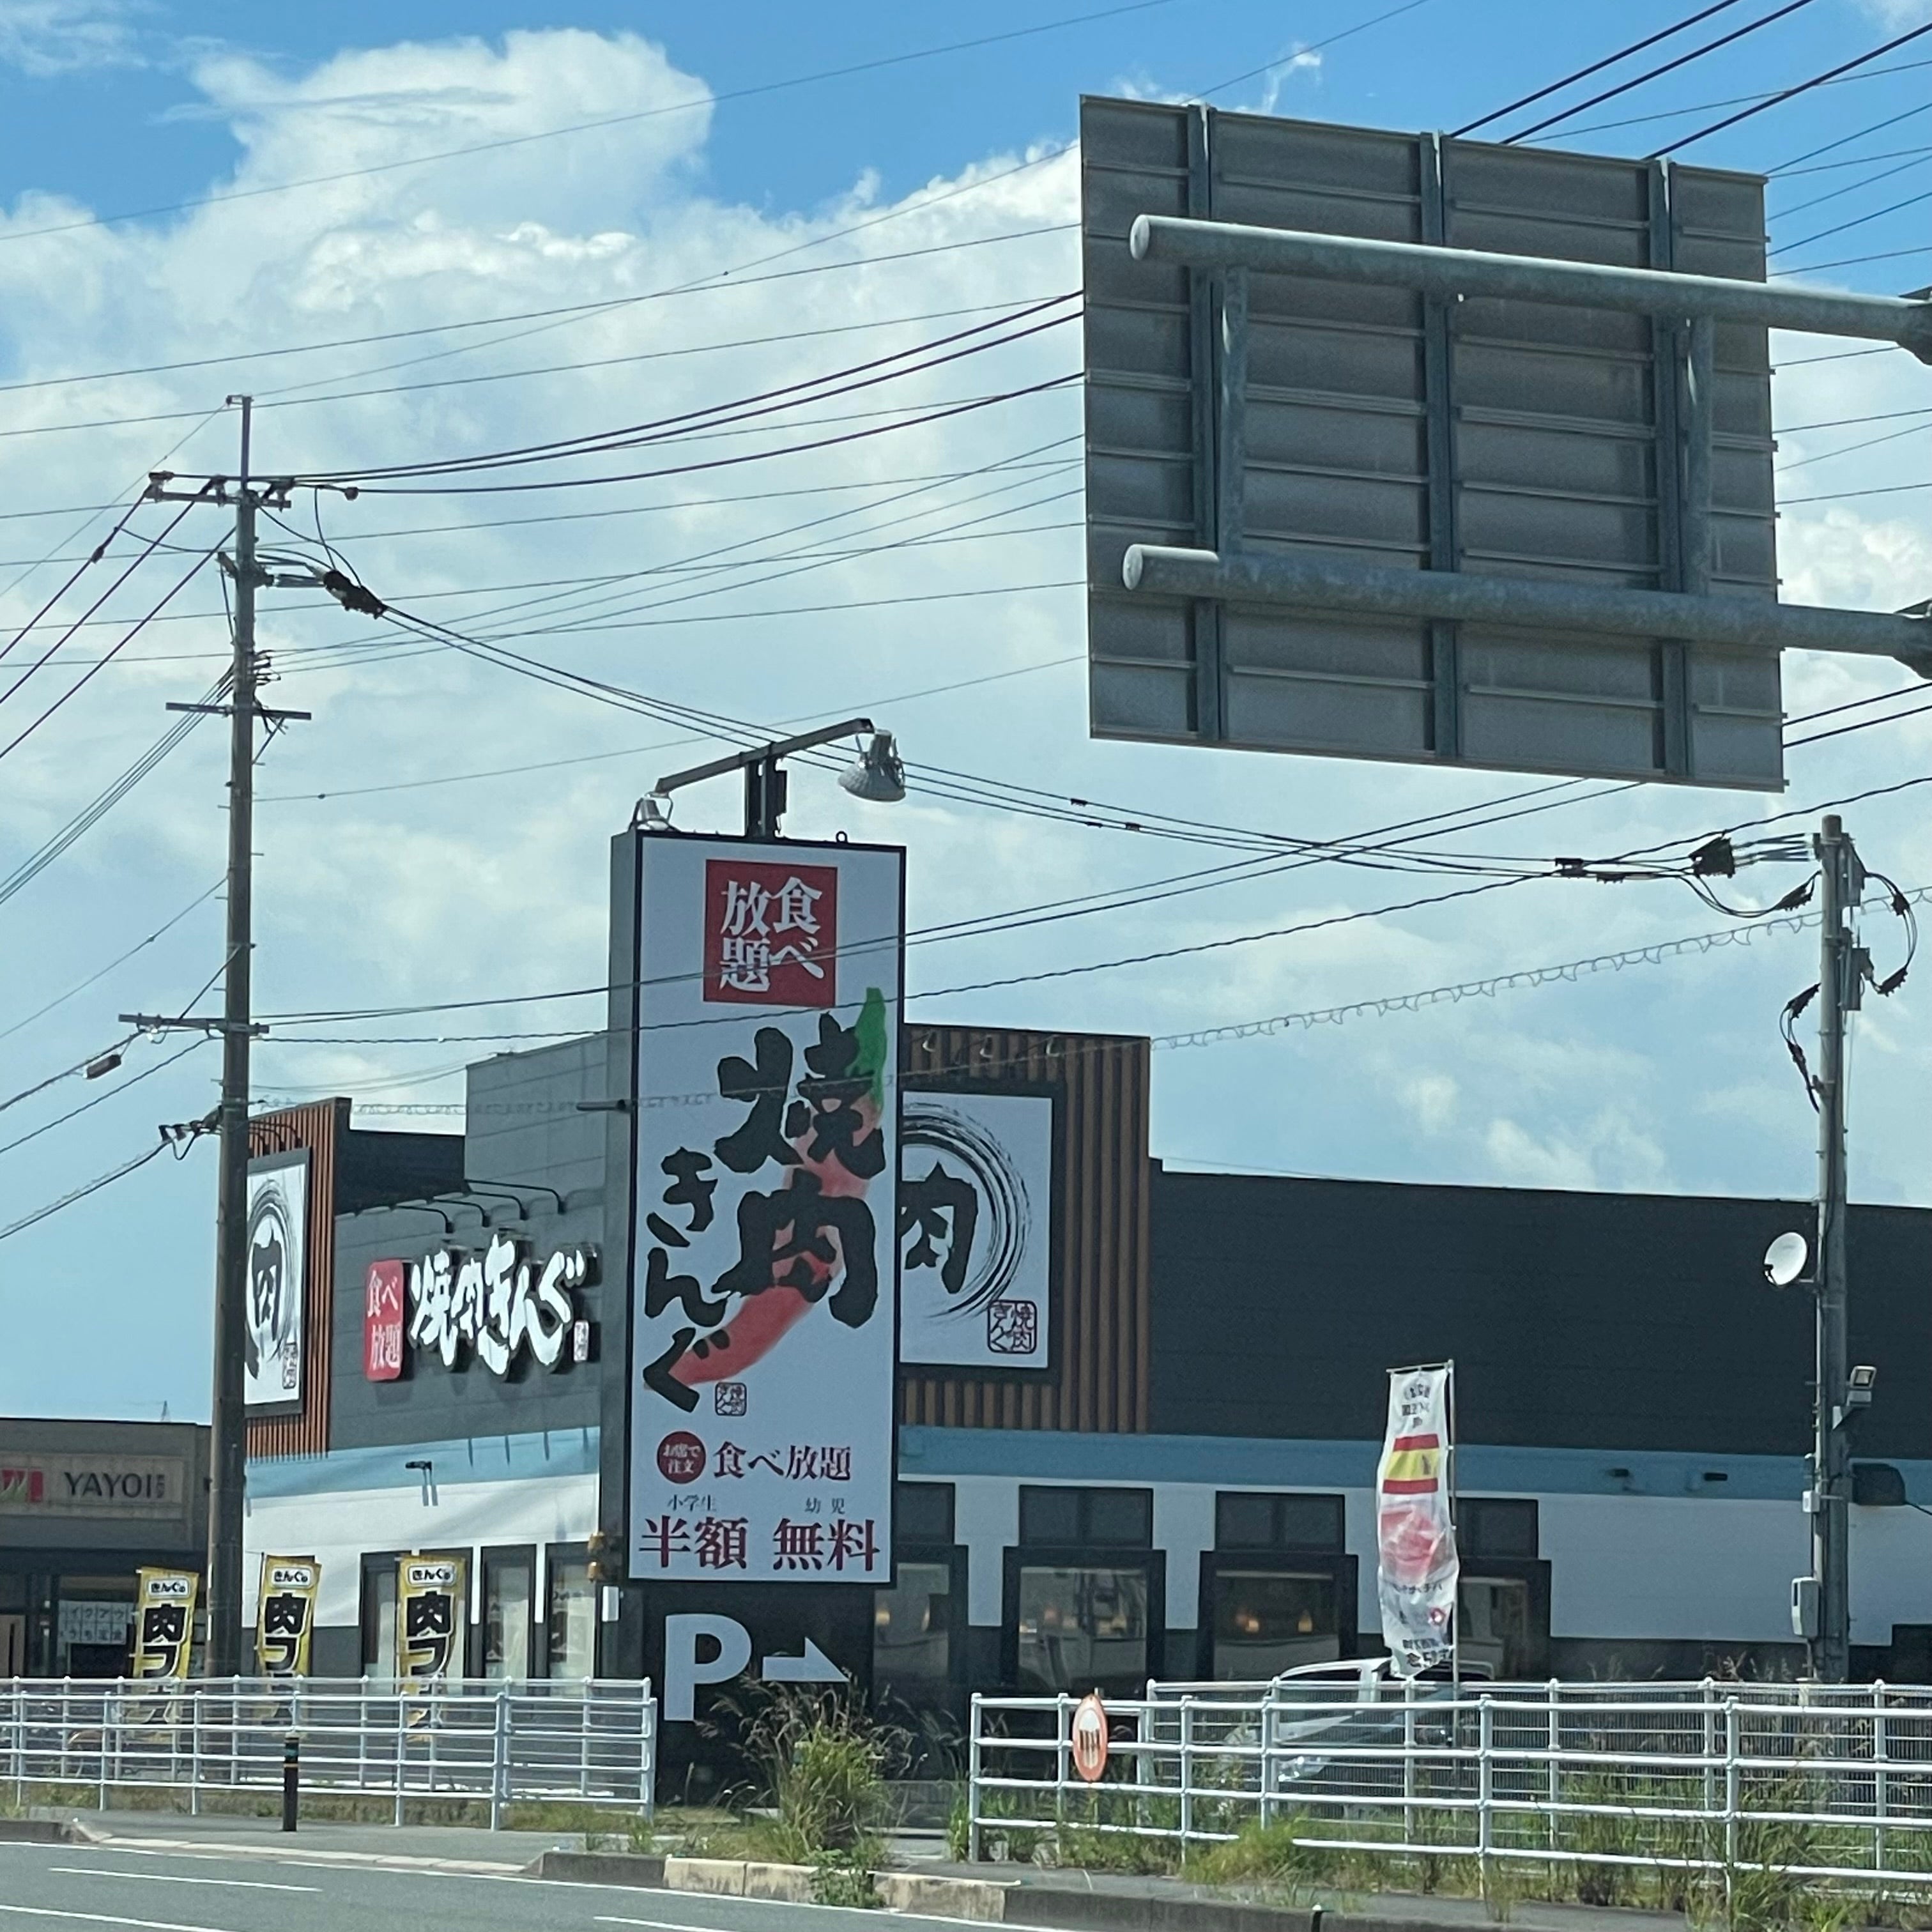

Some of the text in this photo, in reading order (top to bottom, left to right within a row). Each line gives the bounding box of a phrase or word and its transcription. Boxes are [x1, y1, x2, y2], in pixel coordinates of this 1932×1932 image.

[719, 880, 772, 993] 放題
[771, 876, 825, 979] 食べ
[366, 1271, 400, 1318] 食べ
[642, 1147, 730, 1413] きんぐ
[368, 1324, 402, 1372] 放題
[65, 1471, 152, 1499] YAYOI
[714, 1441, 852, 1481] 食べ放題
[667, 1494, 717, 1512] 小学生
[639, 1515, 749, 1570] 半額
[772, 1517, 881, 1572] 無料
[663, 1613, 753, 1722] P
